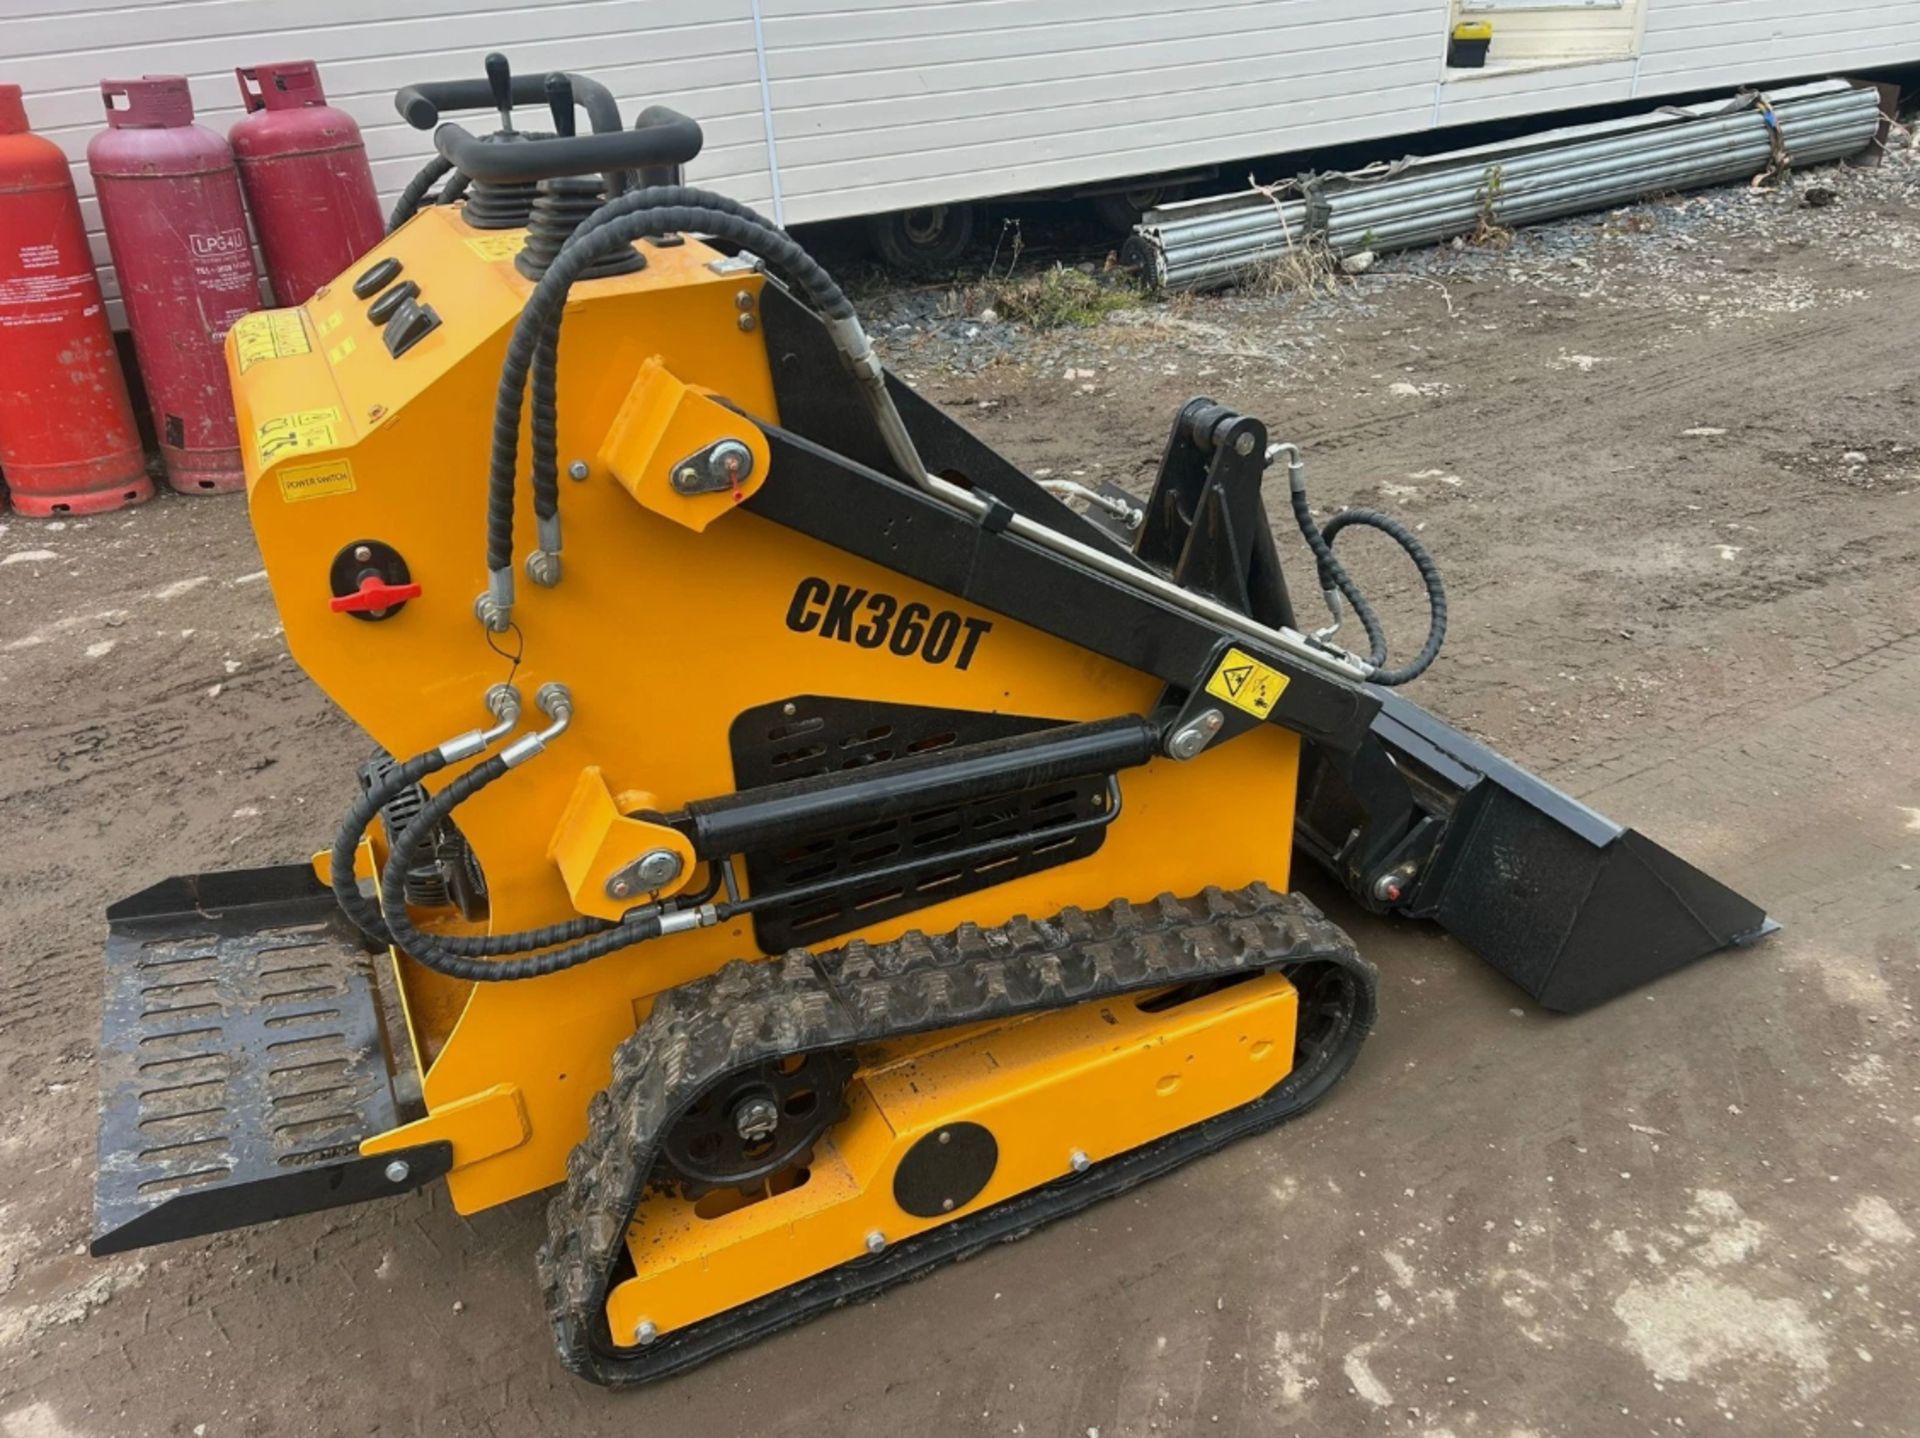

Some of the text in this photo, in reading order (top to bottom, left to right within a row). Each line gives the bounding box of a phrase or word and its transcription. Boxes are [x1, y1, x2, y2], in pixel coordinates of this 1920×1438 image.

[196, 232, 243, 253] LPG4U
[287, 472, 348, 490] POWER SWITCH
[785, 576, 993, 671] CK360T
